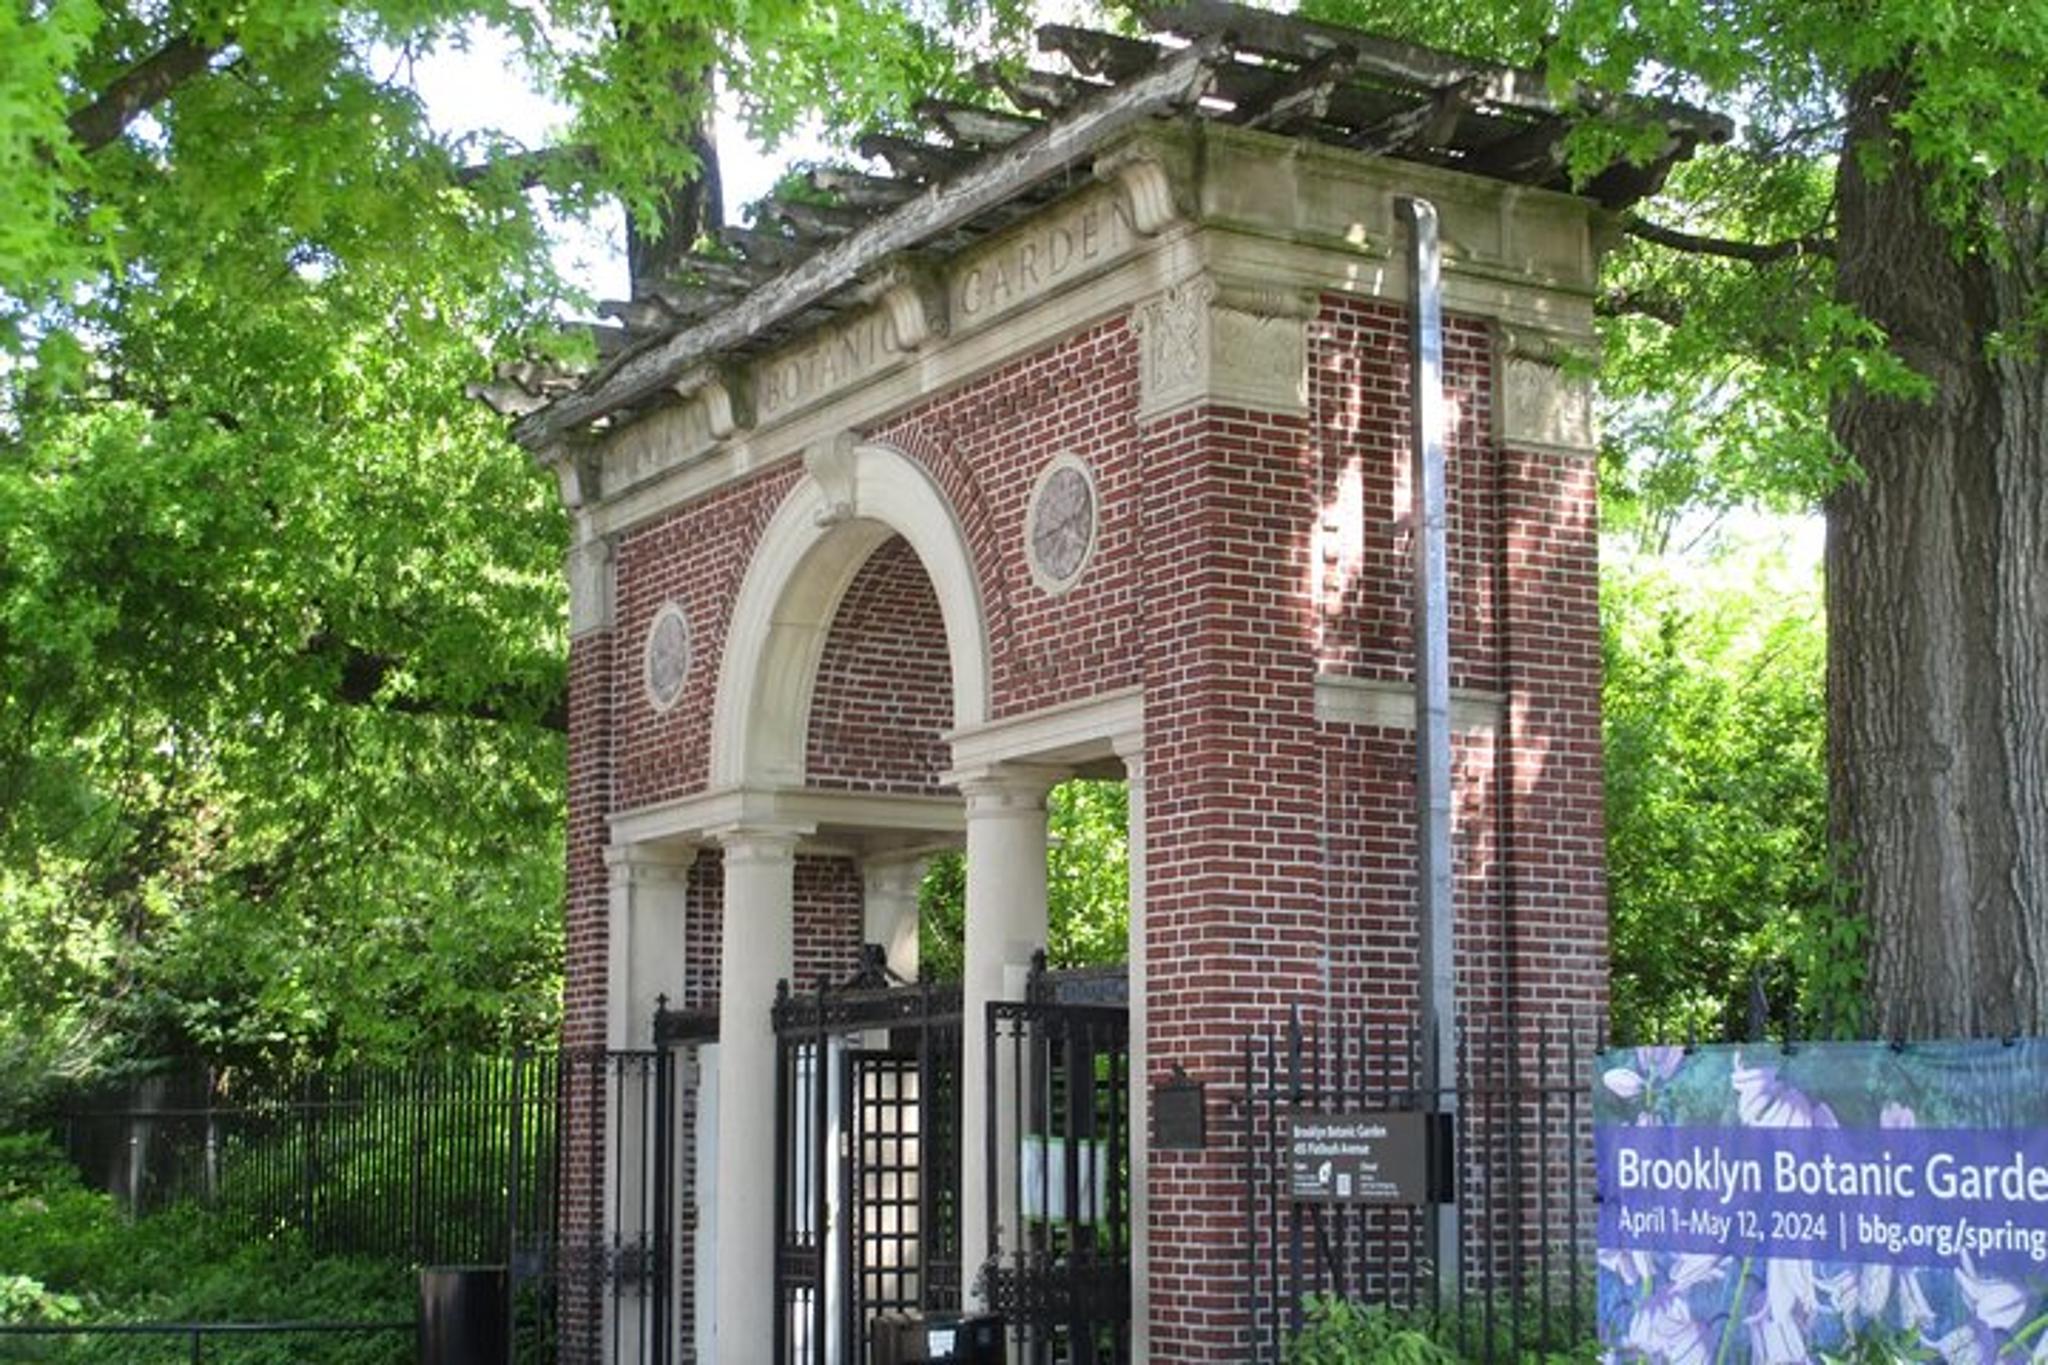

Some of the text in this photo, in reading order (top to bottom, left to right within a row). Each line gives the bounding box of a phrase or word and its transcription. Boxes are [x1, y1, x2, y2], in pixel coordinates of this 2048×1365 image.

[962, 201, 1135, 314] GARDEN
[1293, 1123, 1387, 1141] Brooklyn Botanic Garden
[1618, 1146, 1762, 1204] Brooklyn
[1774, 1151, 1915, 1199] Botanic
[1618, 1205, 1665, 1240] April
[1737, 1210, 1765, 1243] 12,
[1771, 1211, 1828, 1241] 2024
[1857, 1212, 2047, 1262] bbg.org/spring
